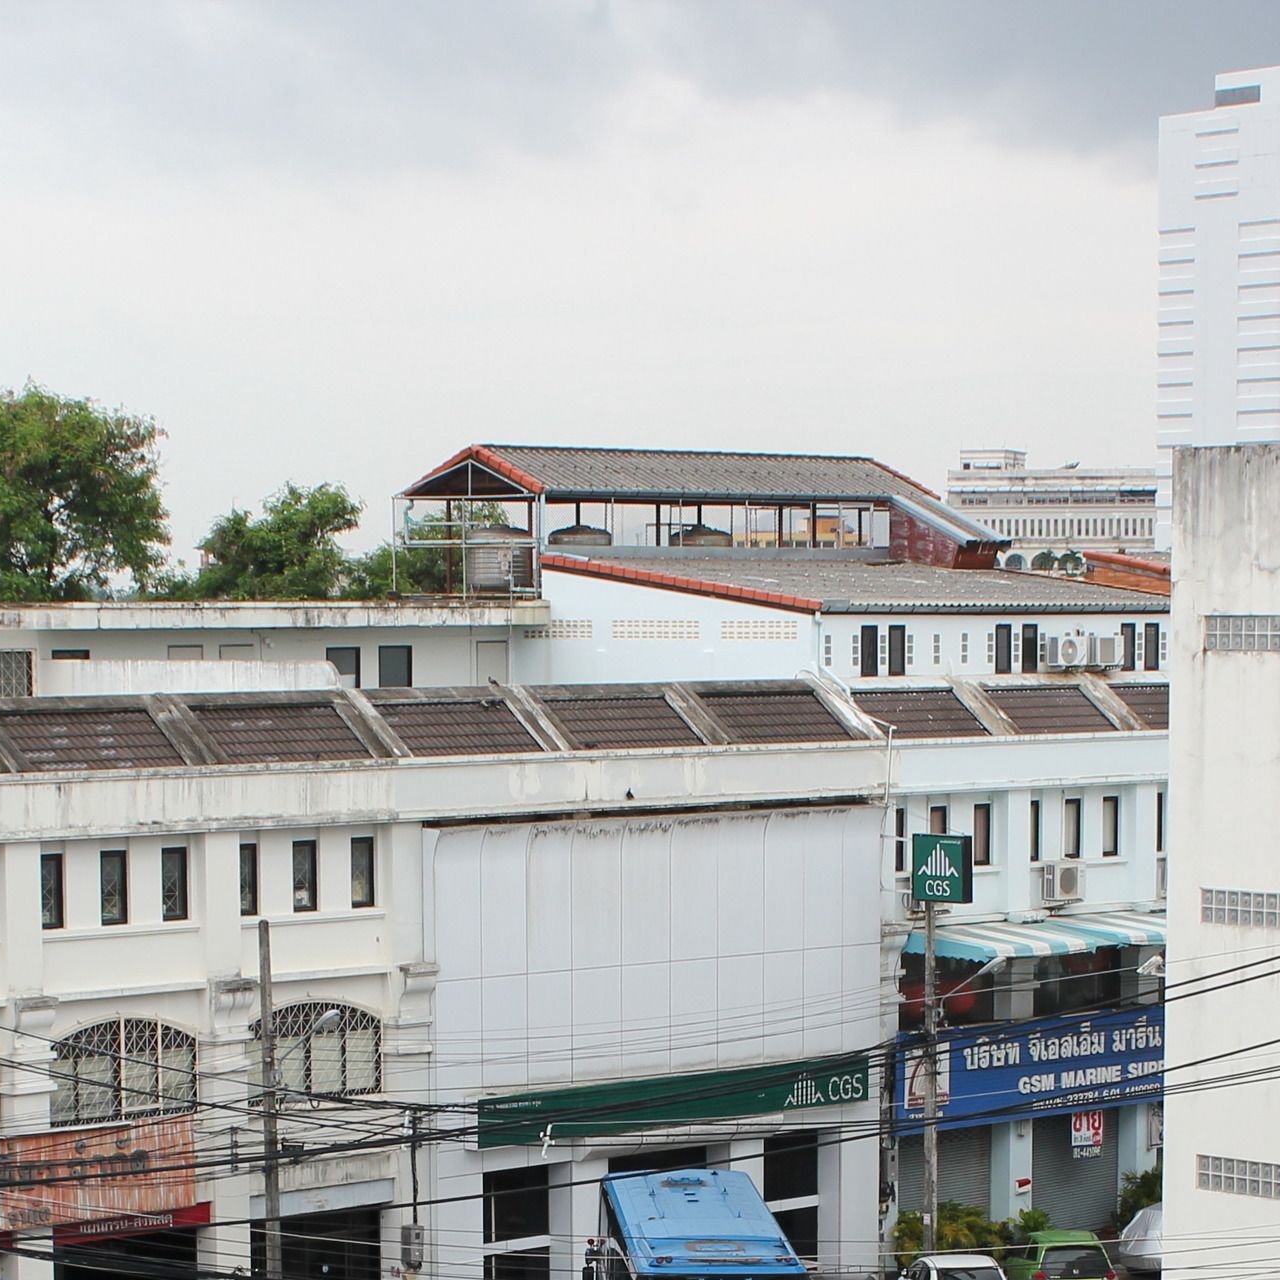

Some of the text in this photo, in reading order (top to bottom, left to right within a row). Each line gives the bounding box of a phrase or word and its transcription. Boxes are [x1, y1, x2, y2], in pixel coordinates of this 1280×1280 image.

[925, 879, 951, 897] CGS
[828, 1073, 863, 1100] CGS
[1018, 1074, 1056, 1095] GSM
[1060, 1065, 1122, 1089] MARINE
